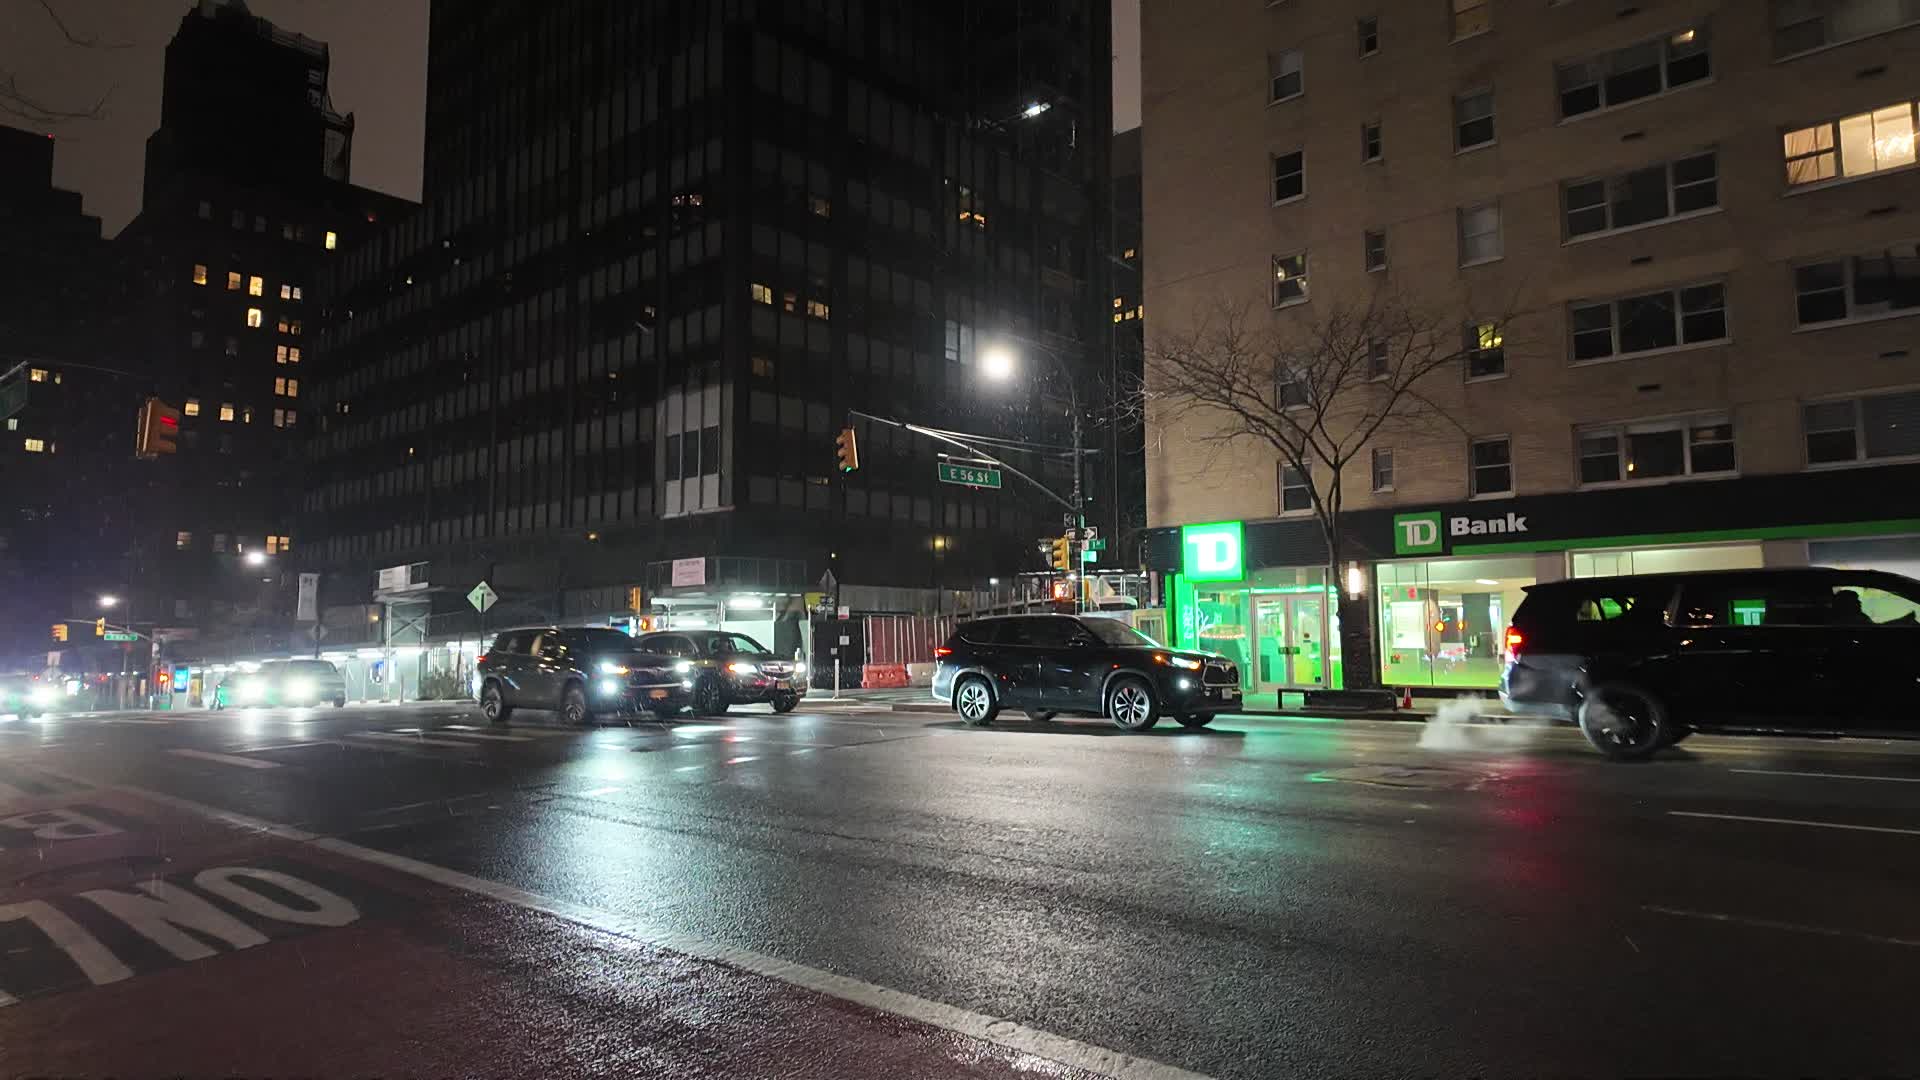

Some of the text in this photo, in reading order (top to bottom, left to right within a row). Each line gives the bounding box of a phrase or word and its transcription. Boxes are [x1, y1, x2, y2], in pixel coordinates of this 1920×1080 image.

[950, 468, 989, 484] E 56 St
[1398, 512, 1528, 546] TD Bank
[1187, 533, 1238, 572] TD
[0, 866, 361, 1006] ONL
